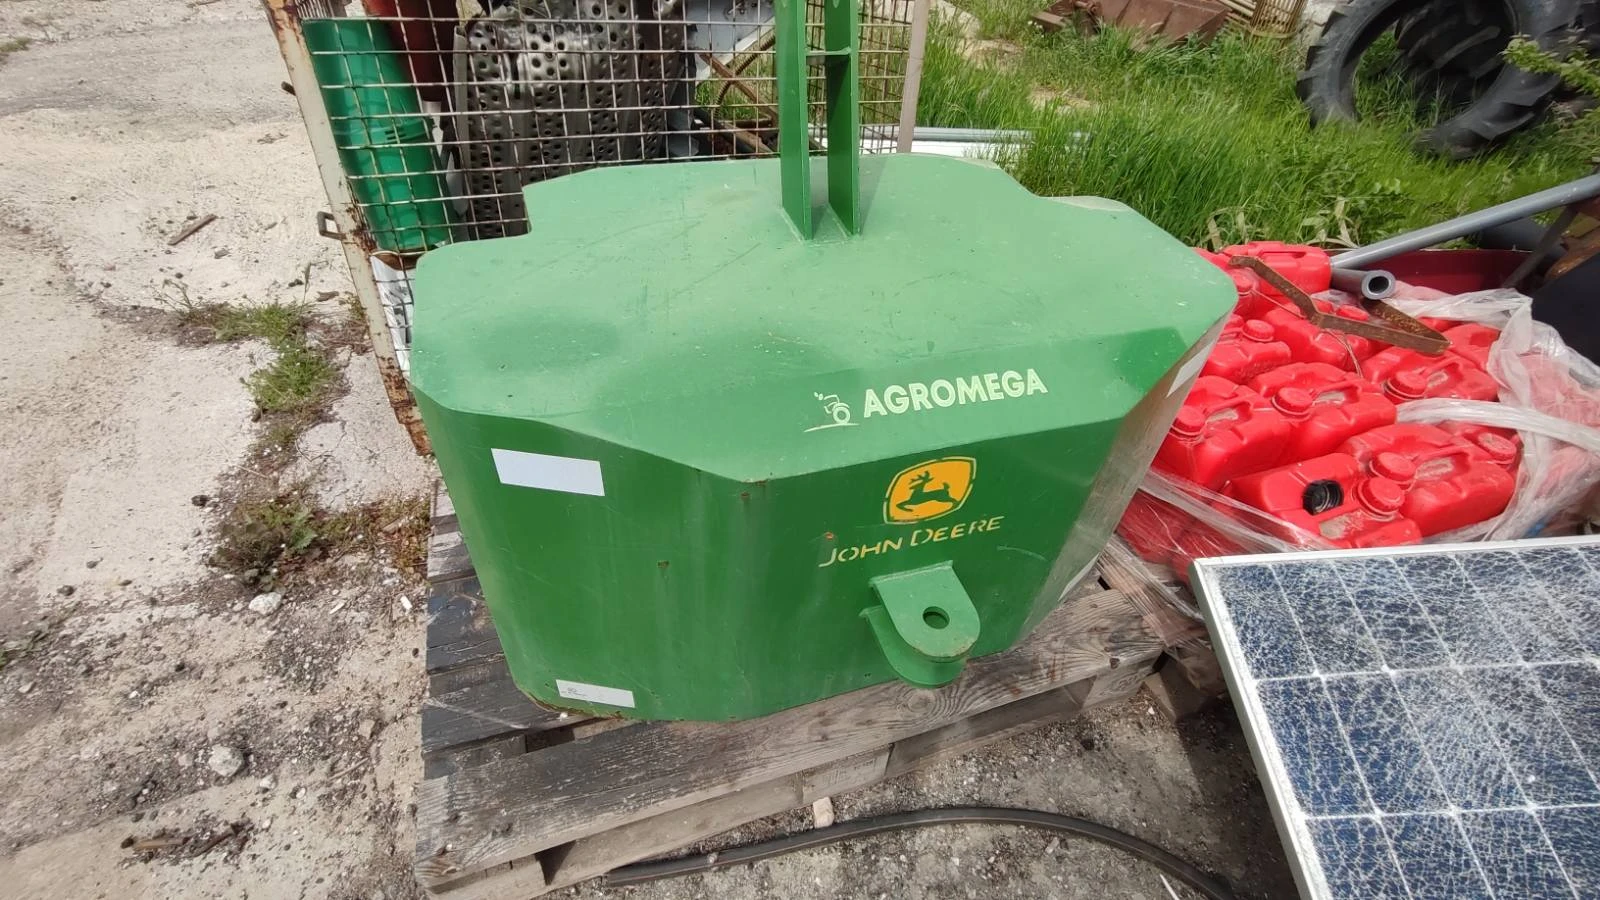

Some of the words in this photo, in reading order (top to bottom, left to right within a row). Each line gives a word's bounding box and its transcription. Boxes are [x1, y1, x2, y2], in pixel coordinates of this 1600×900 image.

[863, 369, 1048, 418] AGROMEGA
[818, 537, 903, 568] JOHN
[910, 515, 1005, 547] DEERE
